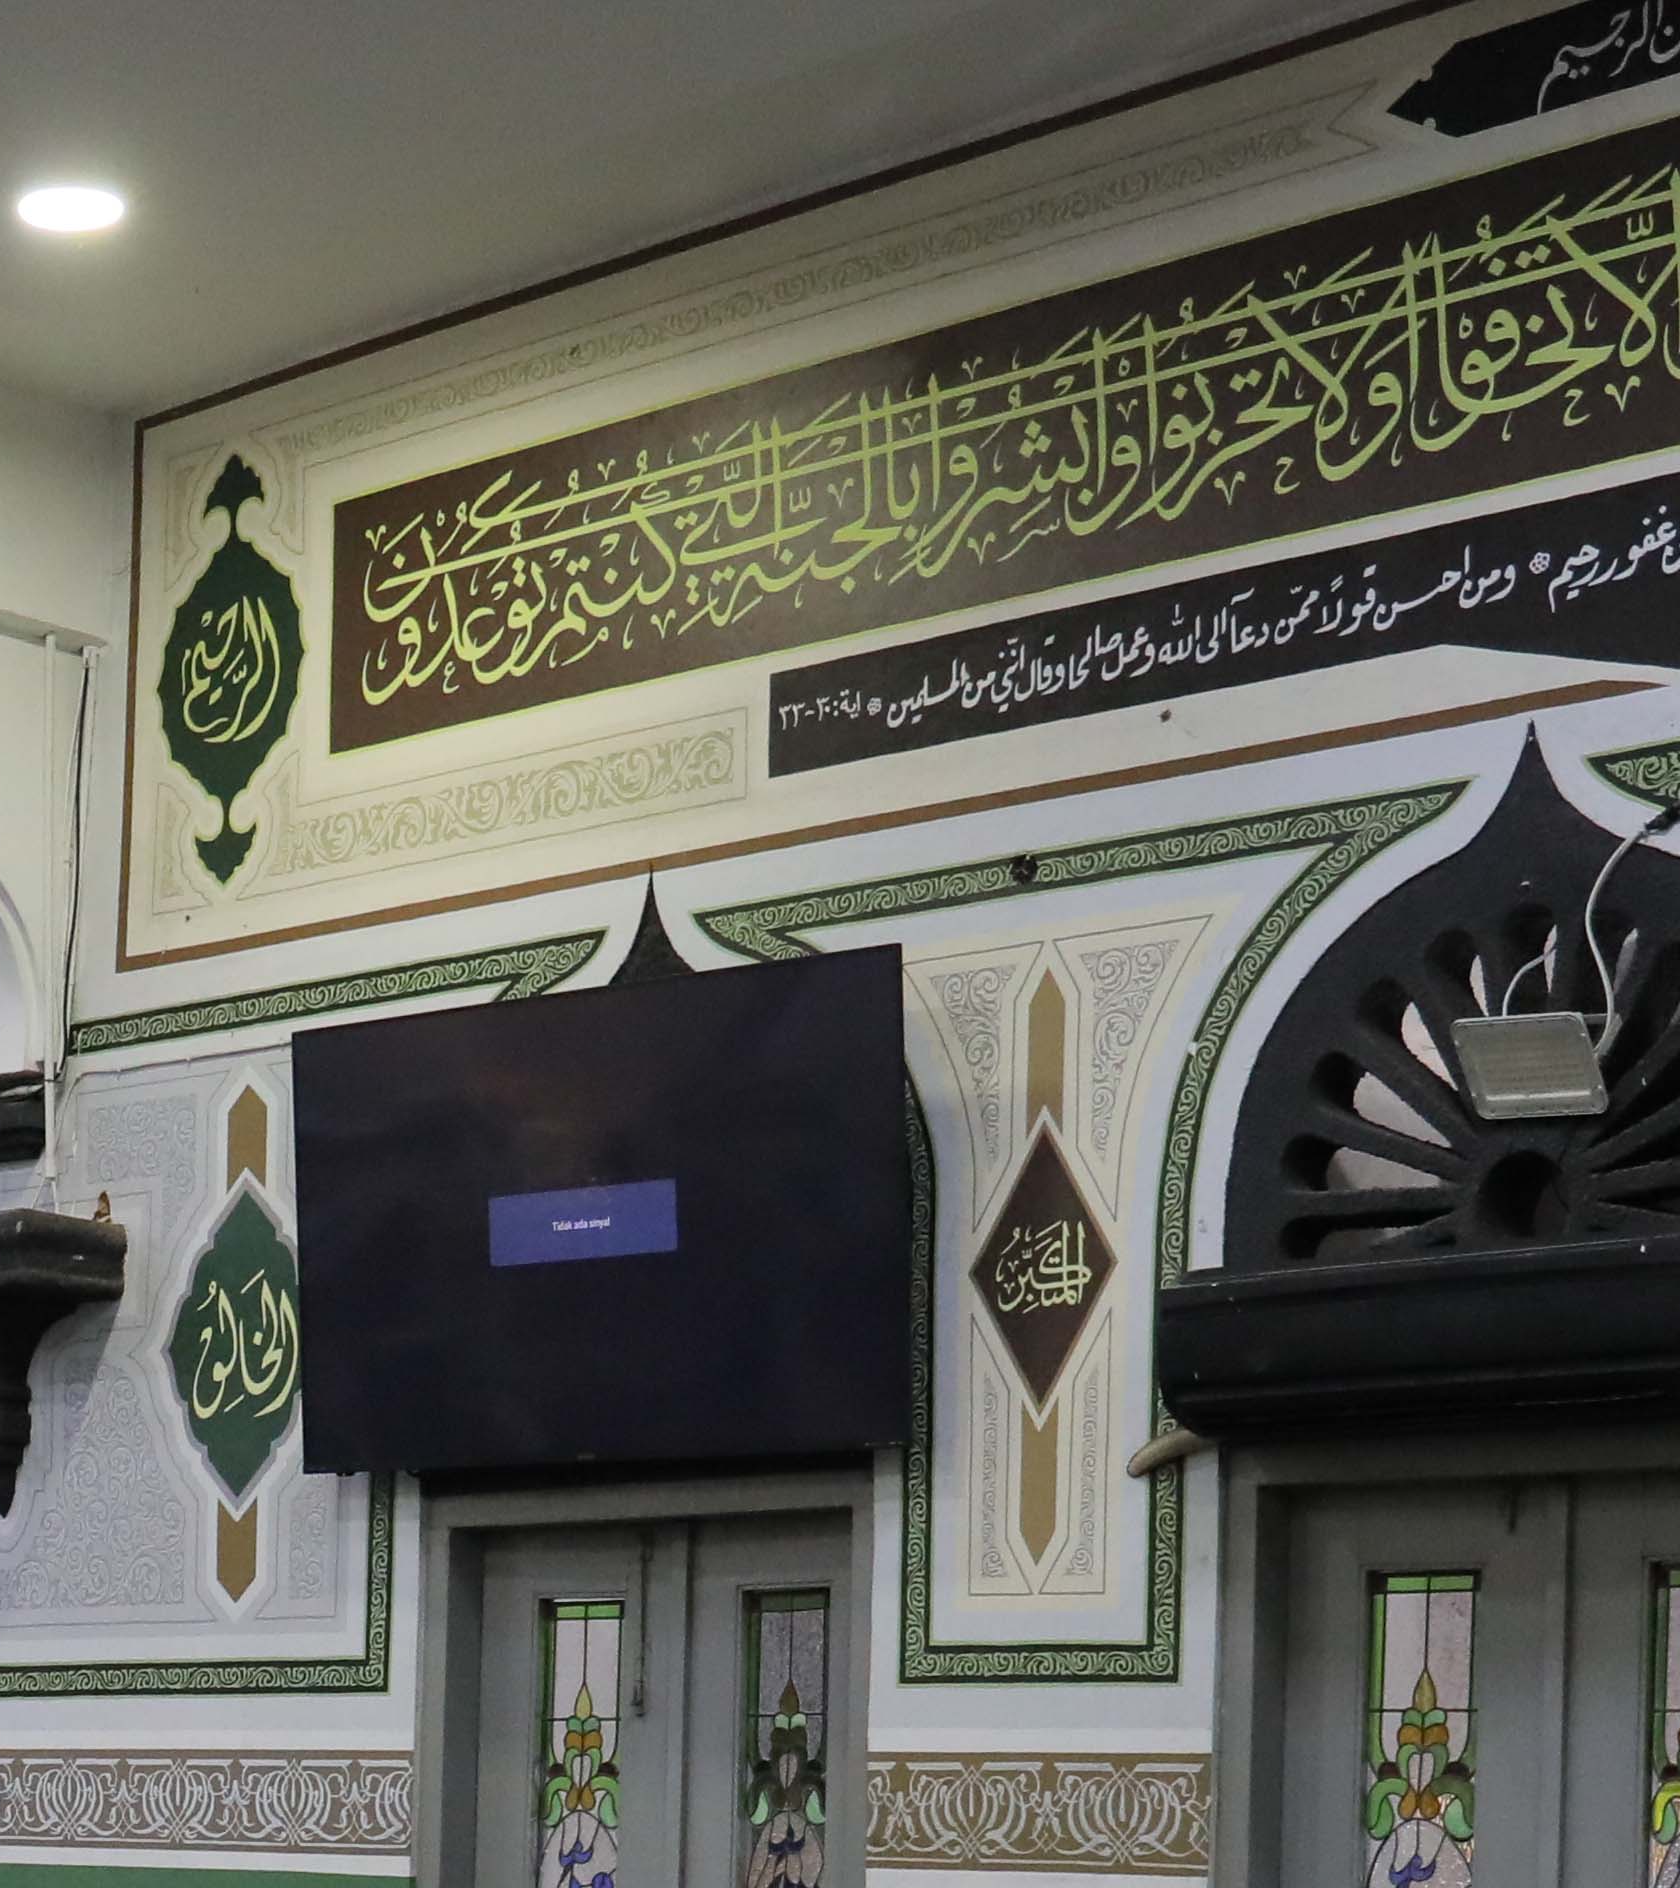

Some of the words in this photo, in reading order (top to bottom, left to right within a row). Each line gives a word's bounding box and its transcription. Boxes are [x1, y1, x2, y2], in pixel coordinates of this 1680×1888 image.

[552, 1221, 572, 1232] Tidak
[574, 1219, 588, 1230] ada
[589, 1216, 611, 1230] sinyal
